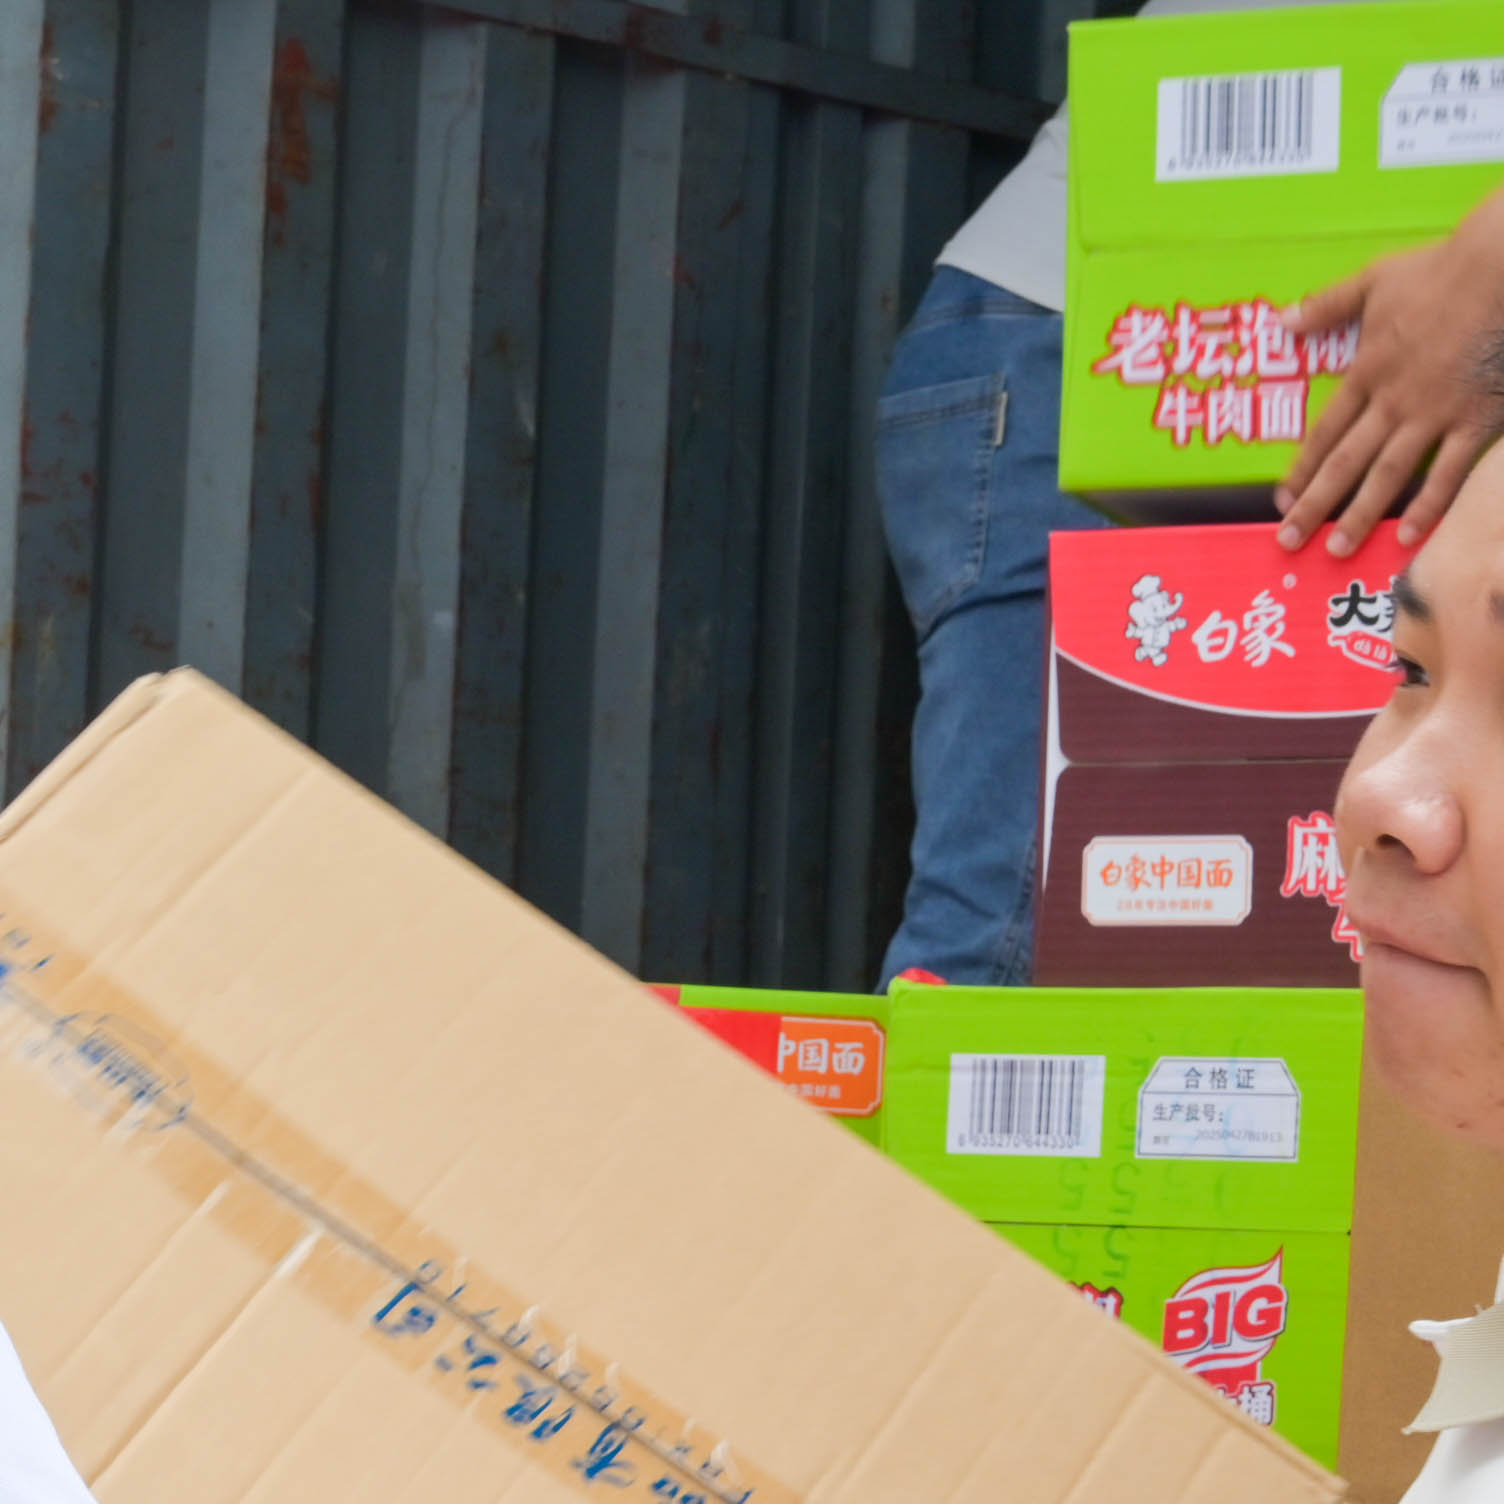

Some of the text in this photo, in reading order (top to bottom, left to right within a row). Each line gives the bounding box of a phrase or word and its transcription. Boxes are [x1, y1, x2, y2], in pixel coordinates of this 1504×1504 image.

[1153, 376, 1309, 446] 牛肉面
[1192, 576, 1396, 667] 白象 大
[1100, 853, 1234, 892] 白象中国面
[1183, 1066, 1257, 1091] 合格证
[1163, 1283, 1288, 1356] BIG
